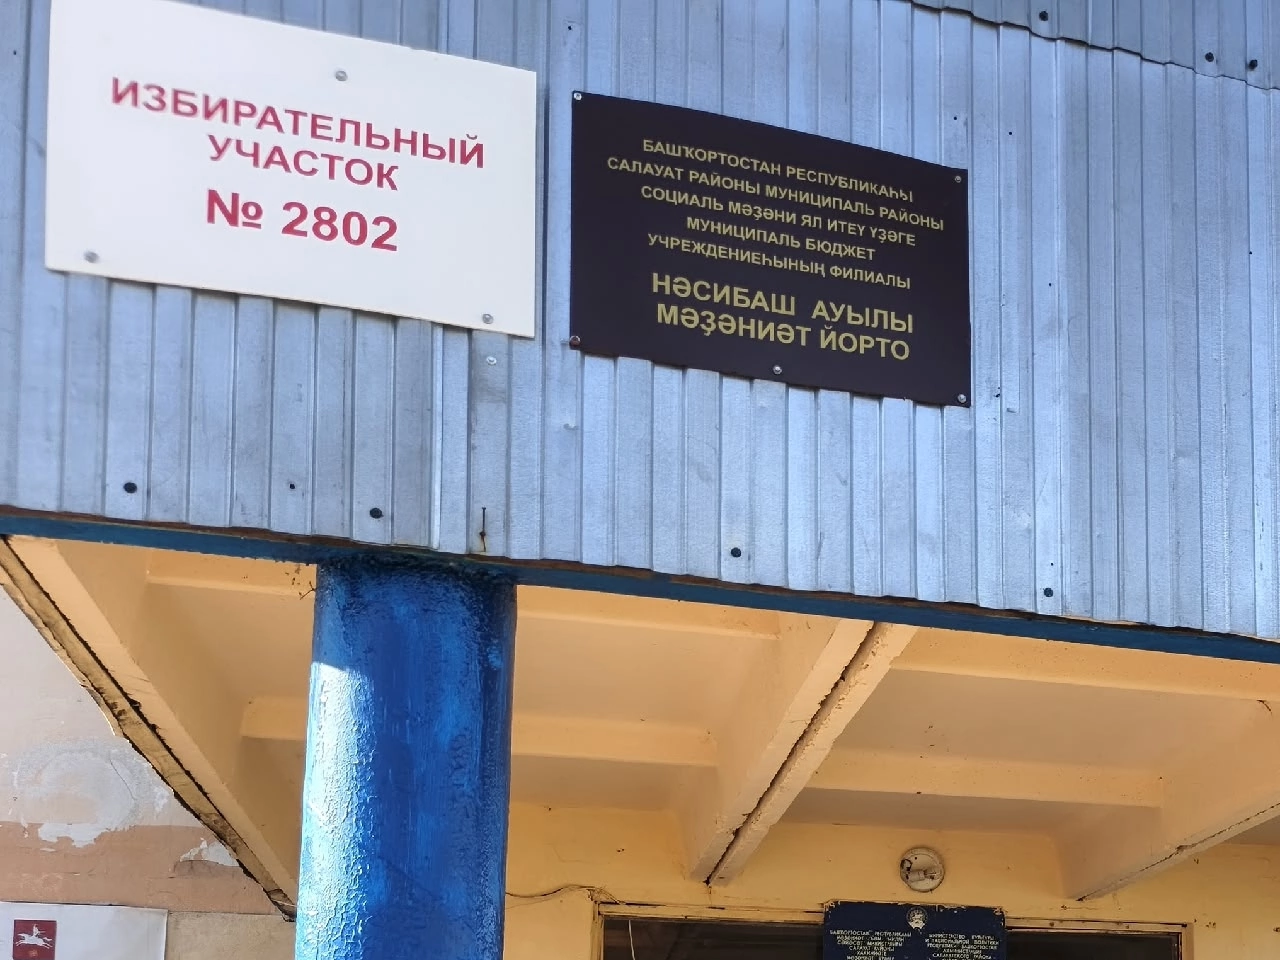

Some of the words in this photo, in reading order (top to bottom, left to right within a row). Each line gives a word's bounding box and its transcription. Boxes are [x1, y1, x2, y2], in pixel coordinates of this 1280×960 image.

[111, 77, 486, 168] ИЗБИРАТЕЛЬНЫЙ
[207, 133, 399, 191] УЧАСТОК
[643, 139, 781, 177] БАШҠОРТОСТАН
[787, 166, 913, 203] РЕСПУБЛИКАҺЫ
[206, 189, 263, 230] №
[281, 201, 398, 251] 2802
[607, 157, 684, 182] САЛАУАТ
[689, 170, 760, 196] РАЙОНЫ
[765, 184, 875, 217] МУНИЦИПАЛЬ
[879, 206, 944, 231] РАЙОНЫ
[641, 185, 724, 211] СОЦИАЛЬ
[728, 201, 796, 225] МӘҘӘНИ
[801, 214, 822, 231] ЯЛ
[827, 218, 865, 237] ИТЕҮ
[869, 226, 916, 247] ҮҘӘГЕ
[648, 233, 826, 278] УЧРЕЖДЕНИЕҺЫНЫҢ
[829, 265, 911, 289] ФИЛИАЛЫ
[686, 216, 801, 249] МУНИЦИПАЛЬ
[805, 237, 876, 261] БЮДЖЕТ
[652, 273, 795, 316] НӘСИБАШ
[811, 300, 913, 333] АУЫЛЫ
[657, 303, 811, 346] МӘҘӘНИӘТ
[820, 324, 911, 360] ЙОРТО
